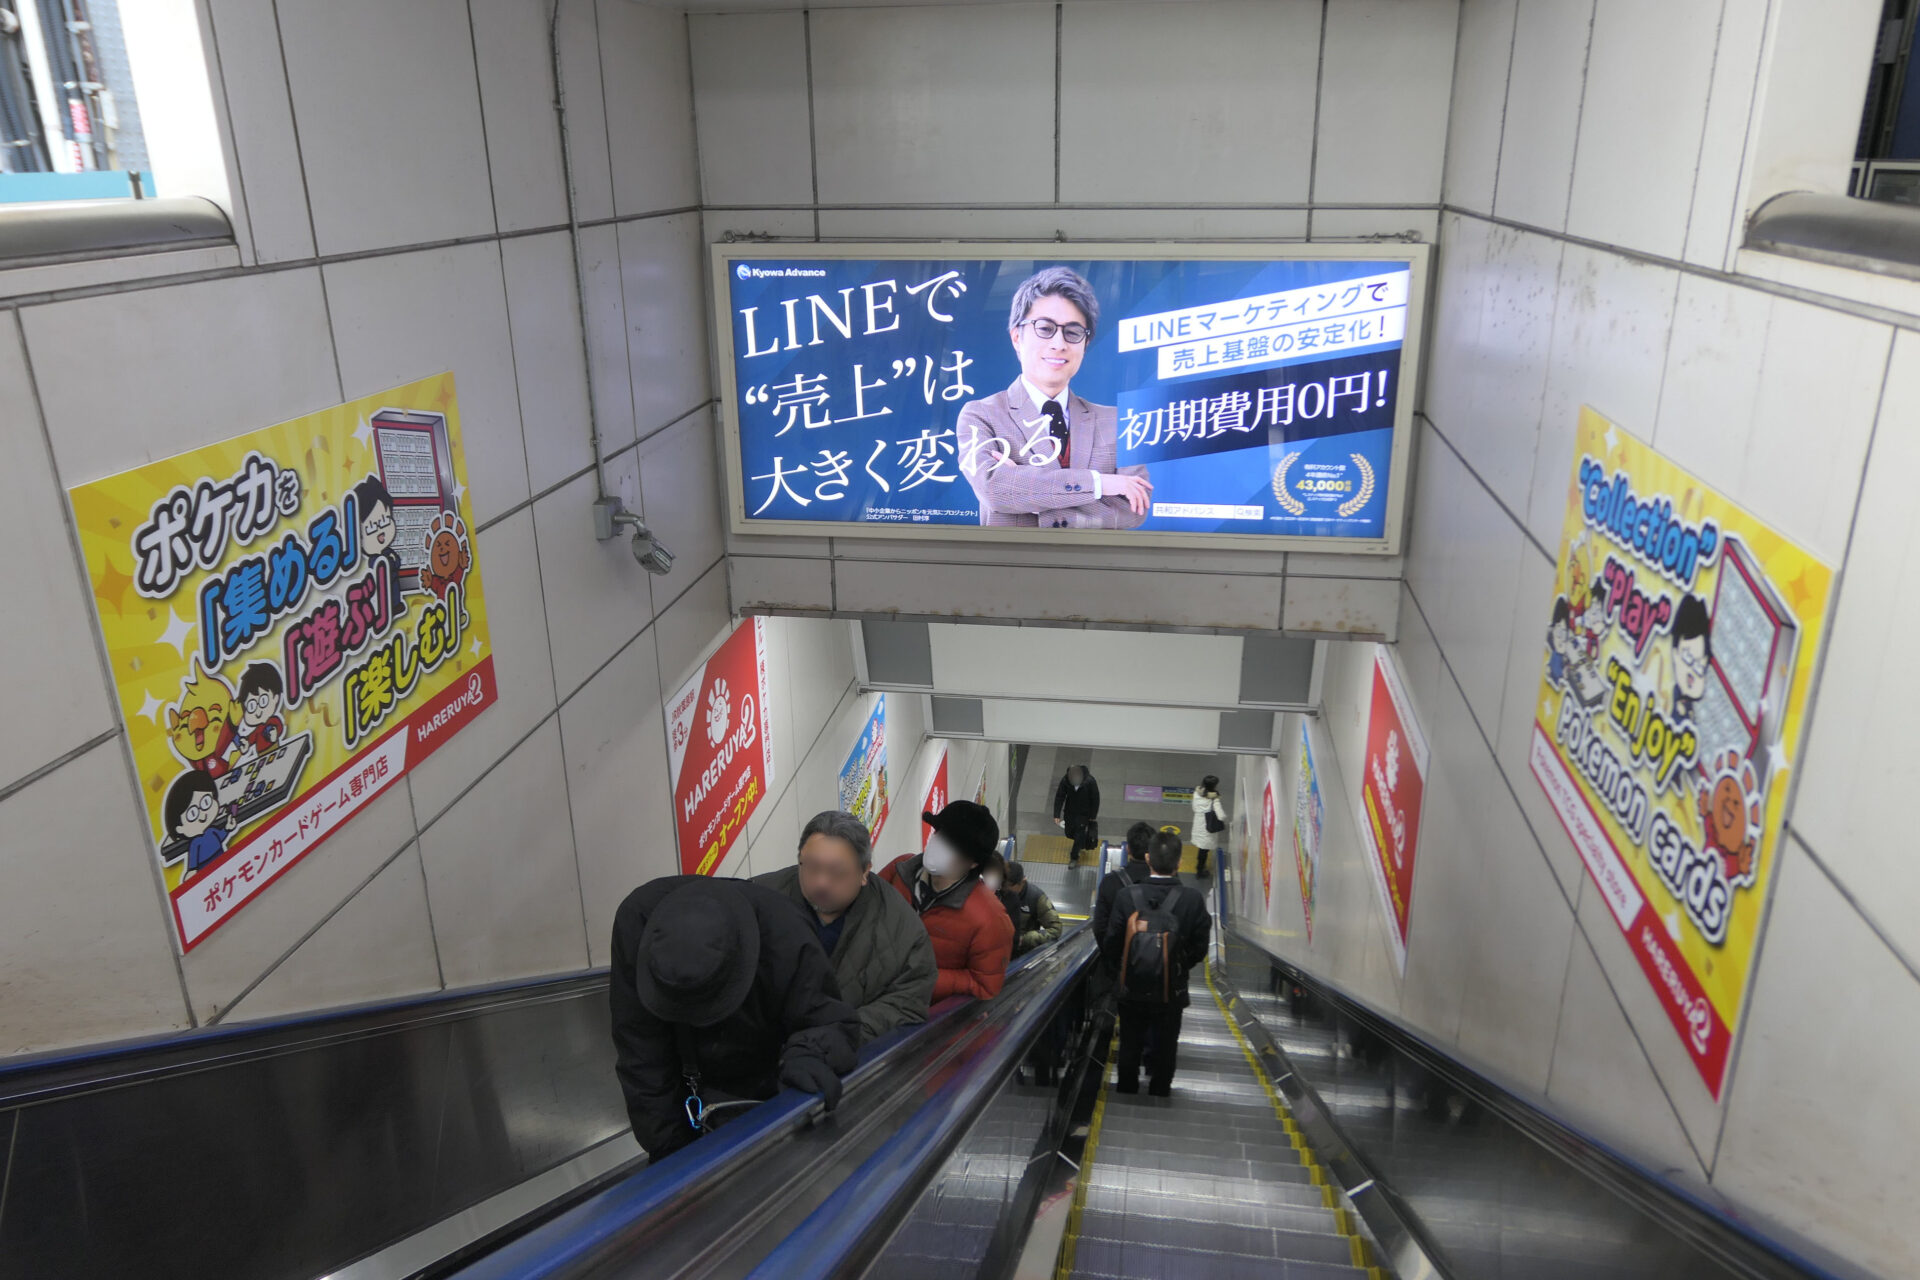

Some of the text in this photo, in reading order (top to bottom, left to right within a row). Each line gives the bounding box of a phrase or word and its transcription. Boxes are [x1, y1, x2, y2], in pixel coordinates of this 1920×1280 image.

[739, 270, 968, 359] LINEで
[752, 267, 826, 279] Kyowa Advance
[1133, 281, 1389, 345] LINEマーケティングで
[136, 452, 301, 597] ポケカを
[751, 413, 1063, 516] 大きく変わる
[1295, 479, 1345, 492] 43,000
[201, 493, 359, 664] 「集める」
[284, 564, 390, 702] 「遊ぶ」
[343, 591, 459, 744] 「楽しむ」
[203, 753, 390, 913] ポケモンカードゲーム専門店
[1558, 692, 1648, 840] Pokemon
